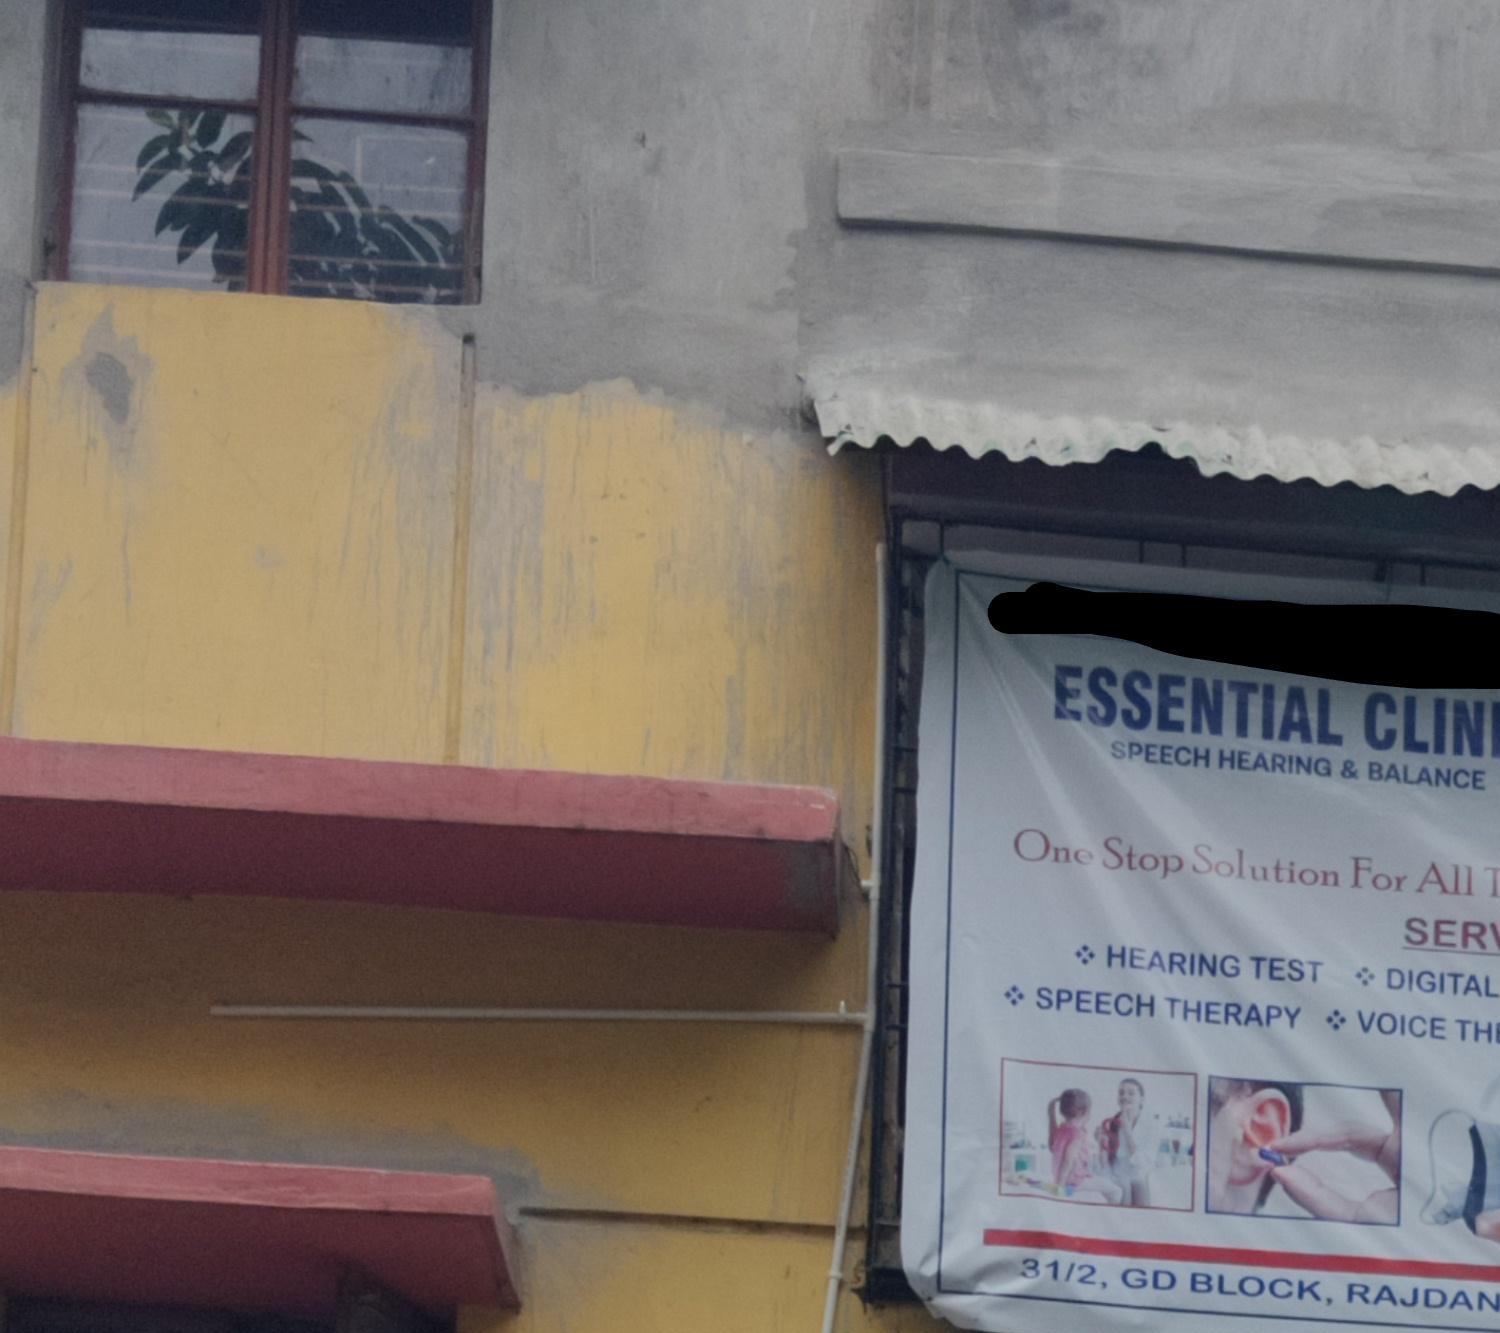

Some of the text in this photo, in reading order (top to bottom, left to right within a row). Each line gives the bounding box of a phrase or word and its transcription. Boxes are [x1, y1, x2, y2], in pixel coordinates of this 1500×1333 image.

[1054, 664, 1343, 748] ESSENTIAL
[1110, 740, 1487, 792] SPEECH HEARING & BALANCE
[1013, 828, 1094, 866] One
[1102, 836, 1185, 882] Stop
[1192, 843, 1341, 889] Solution
[1350, 856, 1407, 893] For
[1414, 863, 1474, 898] All
[1106, 945, 1242, 982] HEARING
[1251, 956, 1324, 984] TEST
[1386, 969, 1500, 999] DIGITAL
[1036, 987, 1156, 1018] SPEECH
[1166, 995, 1302, 1030] THERAPY
[1357, 1010, 1447, 1042] VOICE
[1020, 1257, 1108, 1290] 31/2,
[1121, 1267, 1177, 1292] GD
[1191, 1272, 1334, 1305] BLOCK,
